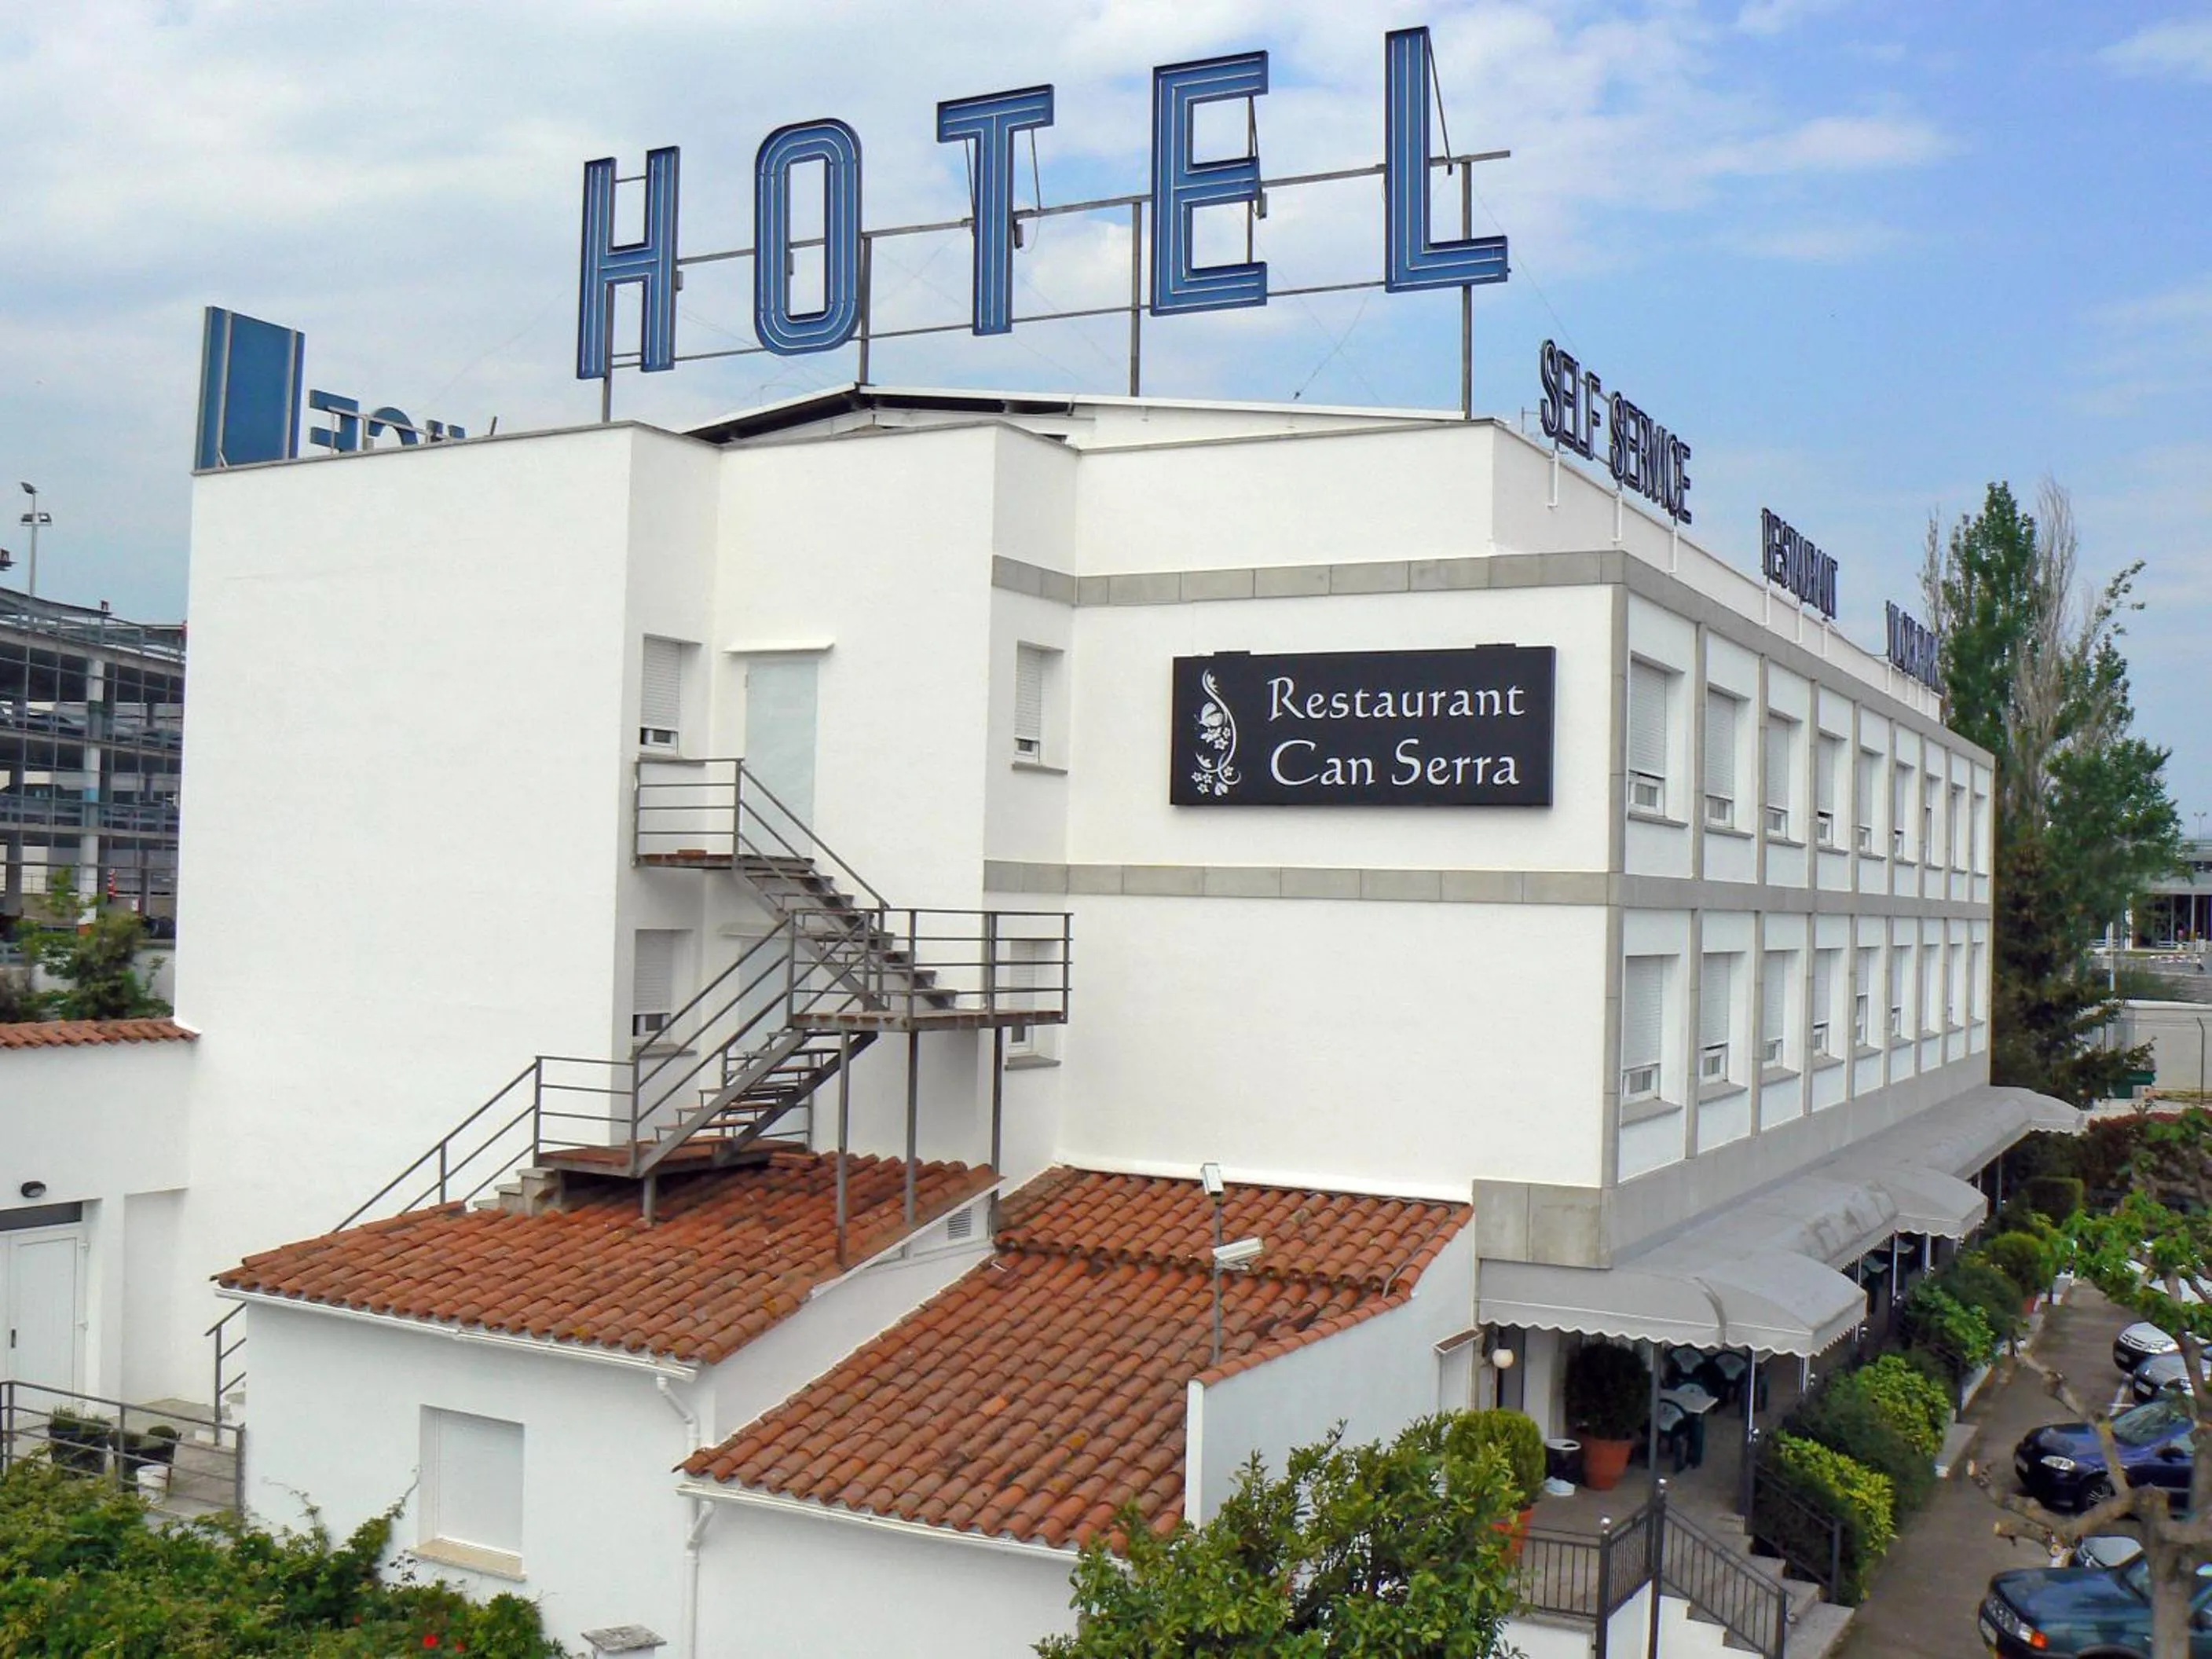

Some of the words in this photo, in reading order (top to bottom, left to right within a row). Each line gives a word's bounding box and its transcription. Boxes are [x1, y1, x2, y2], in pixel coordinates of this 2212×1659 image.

[577, 26, 1509, 379] HOTEL
[1540, 339, 1601, 461] SELF
[1610, 391, 1692, 524] SERVICE
[1267, 676, 1525, 721] Restaurant
[1270, 739, 1375, 786] Can
[1391, 738, 1520, 786] Serra
